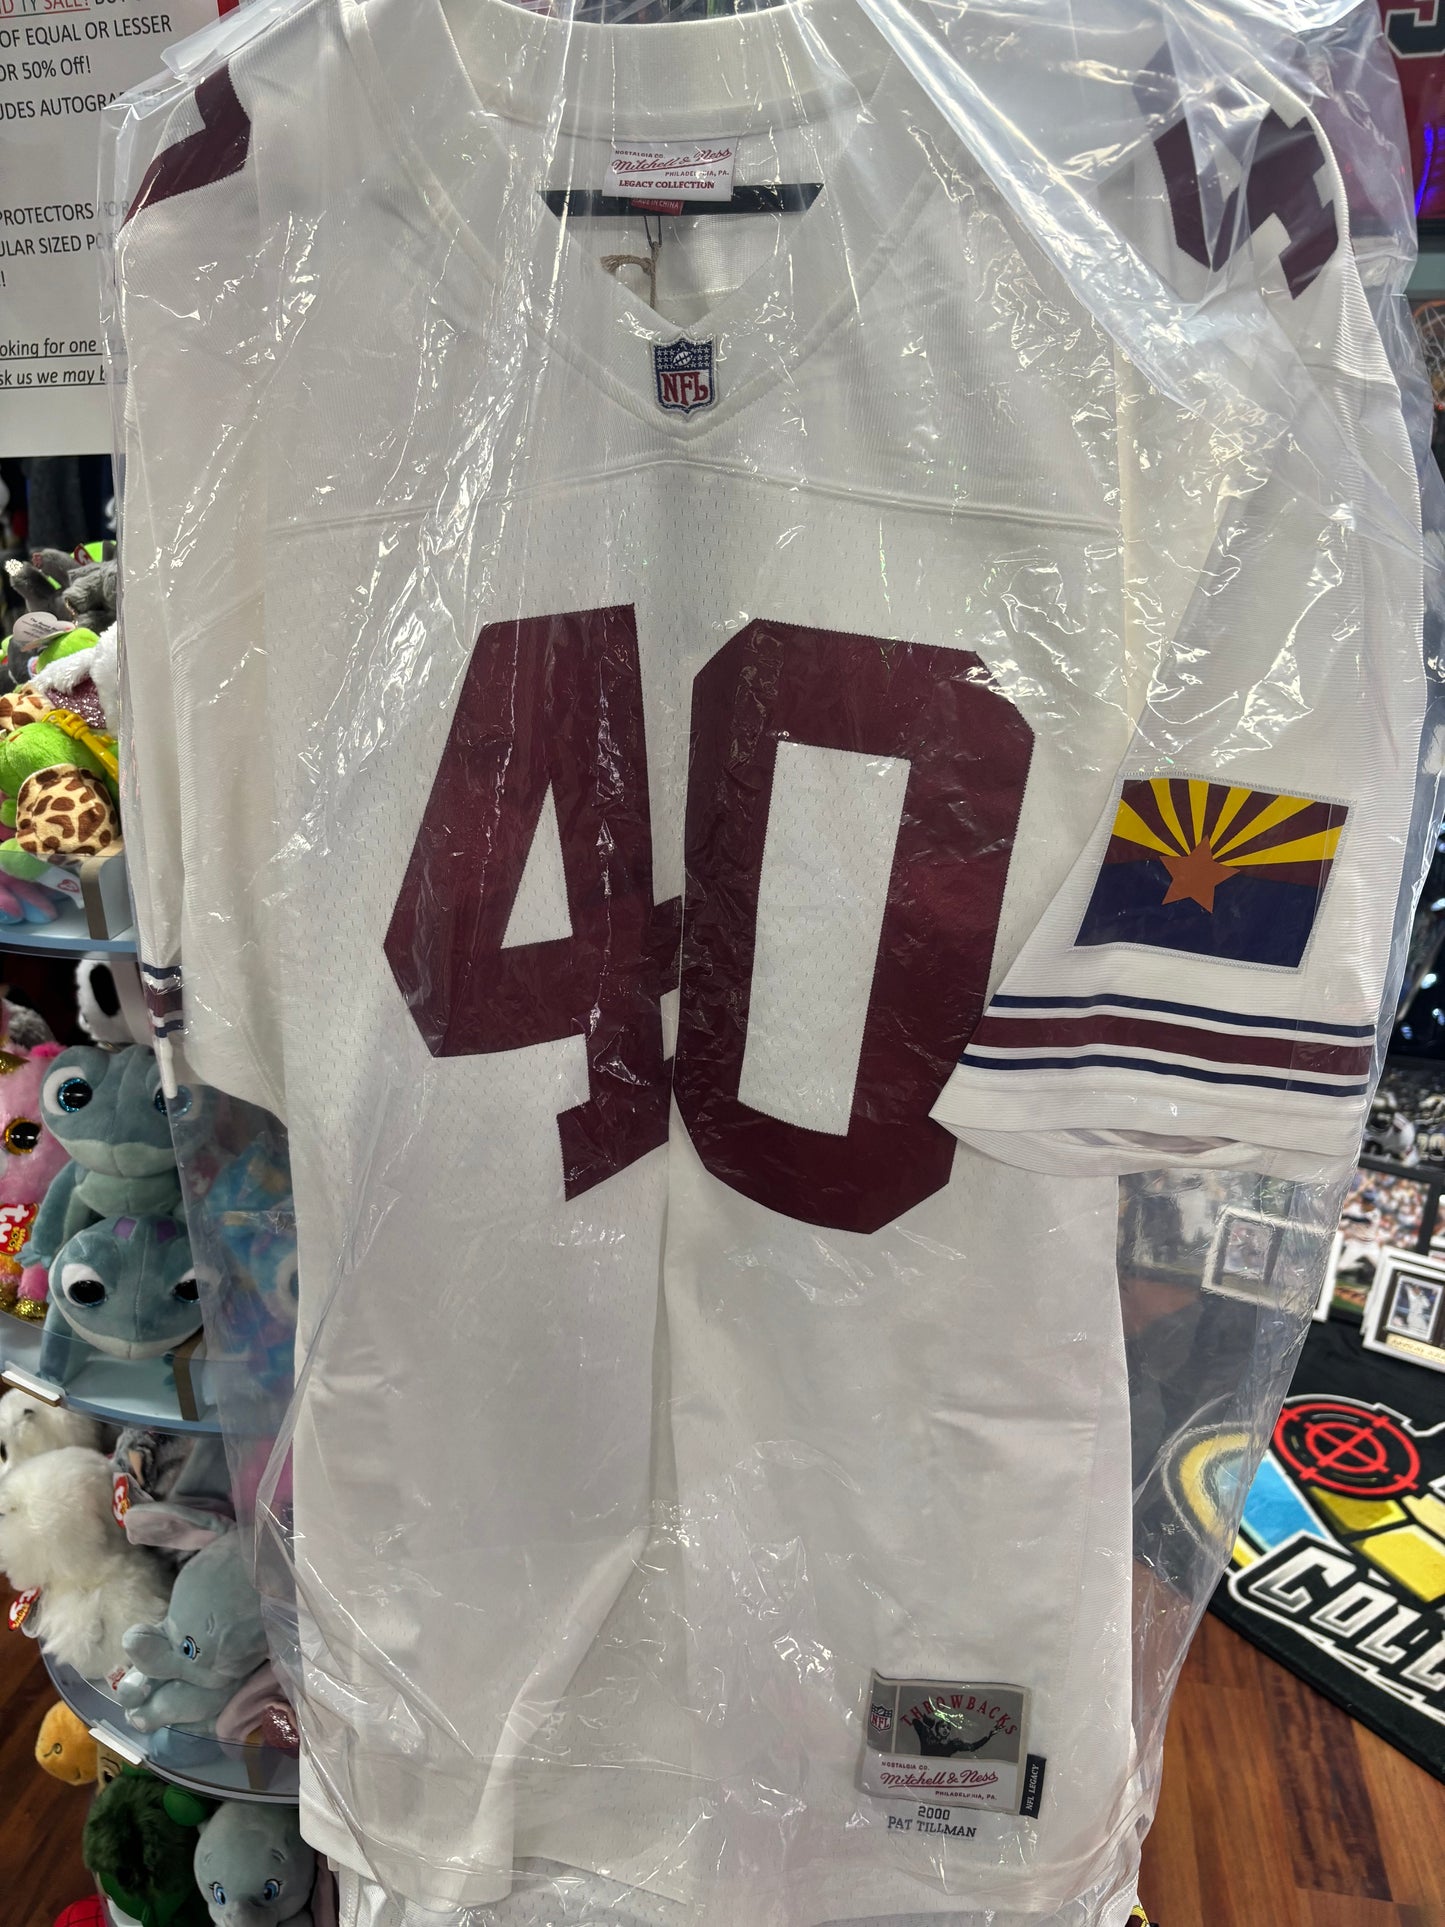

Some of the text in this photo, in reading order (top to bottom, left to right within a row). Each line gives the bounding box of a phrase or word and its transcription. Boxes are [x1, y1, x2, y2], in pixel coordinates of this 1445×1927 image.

[0, 14, 172, 48] OF EQUAL OR LESSER
[22, 59, 57, 80] 50%
[60, 55, 91, 76] Off!
[611, 157, 680, 173] Mitchell
[693, 148, 733, 162] Ness
[618, 179, 716, 190] LEGACY COLLECTION
[659, 200, 679, 209] CHINA
[39, 235, 82, 254] SIZED
[44, 337, 65, 358] for
[69, 339, 97, 353] one
[17, 373, 33, 385] us
[37, 371, 59, 384] we
[63, 369, 96, 385] may
[660, 371, 709, 406] NFL
[383, 602, 1035, 1236] 40
[870, 1713, 890, 1730] NFL
[900, 1694, 1018, 1736] THROWBACKS
[881, 1761, 917, 1770] NOSTALGIA
[880, 1769, 999, 1786] Mitchell & Ness
[1025, 1763, 1040, 1811] NFL LEGACY
[917, 1805, 951, 1822] 2000
[887, 1815, 978, 1838] PAT TILLMAN
